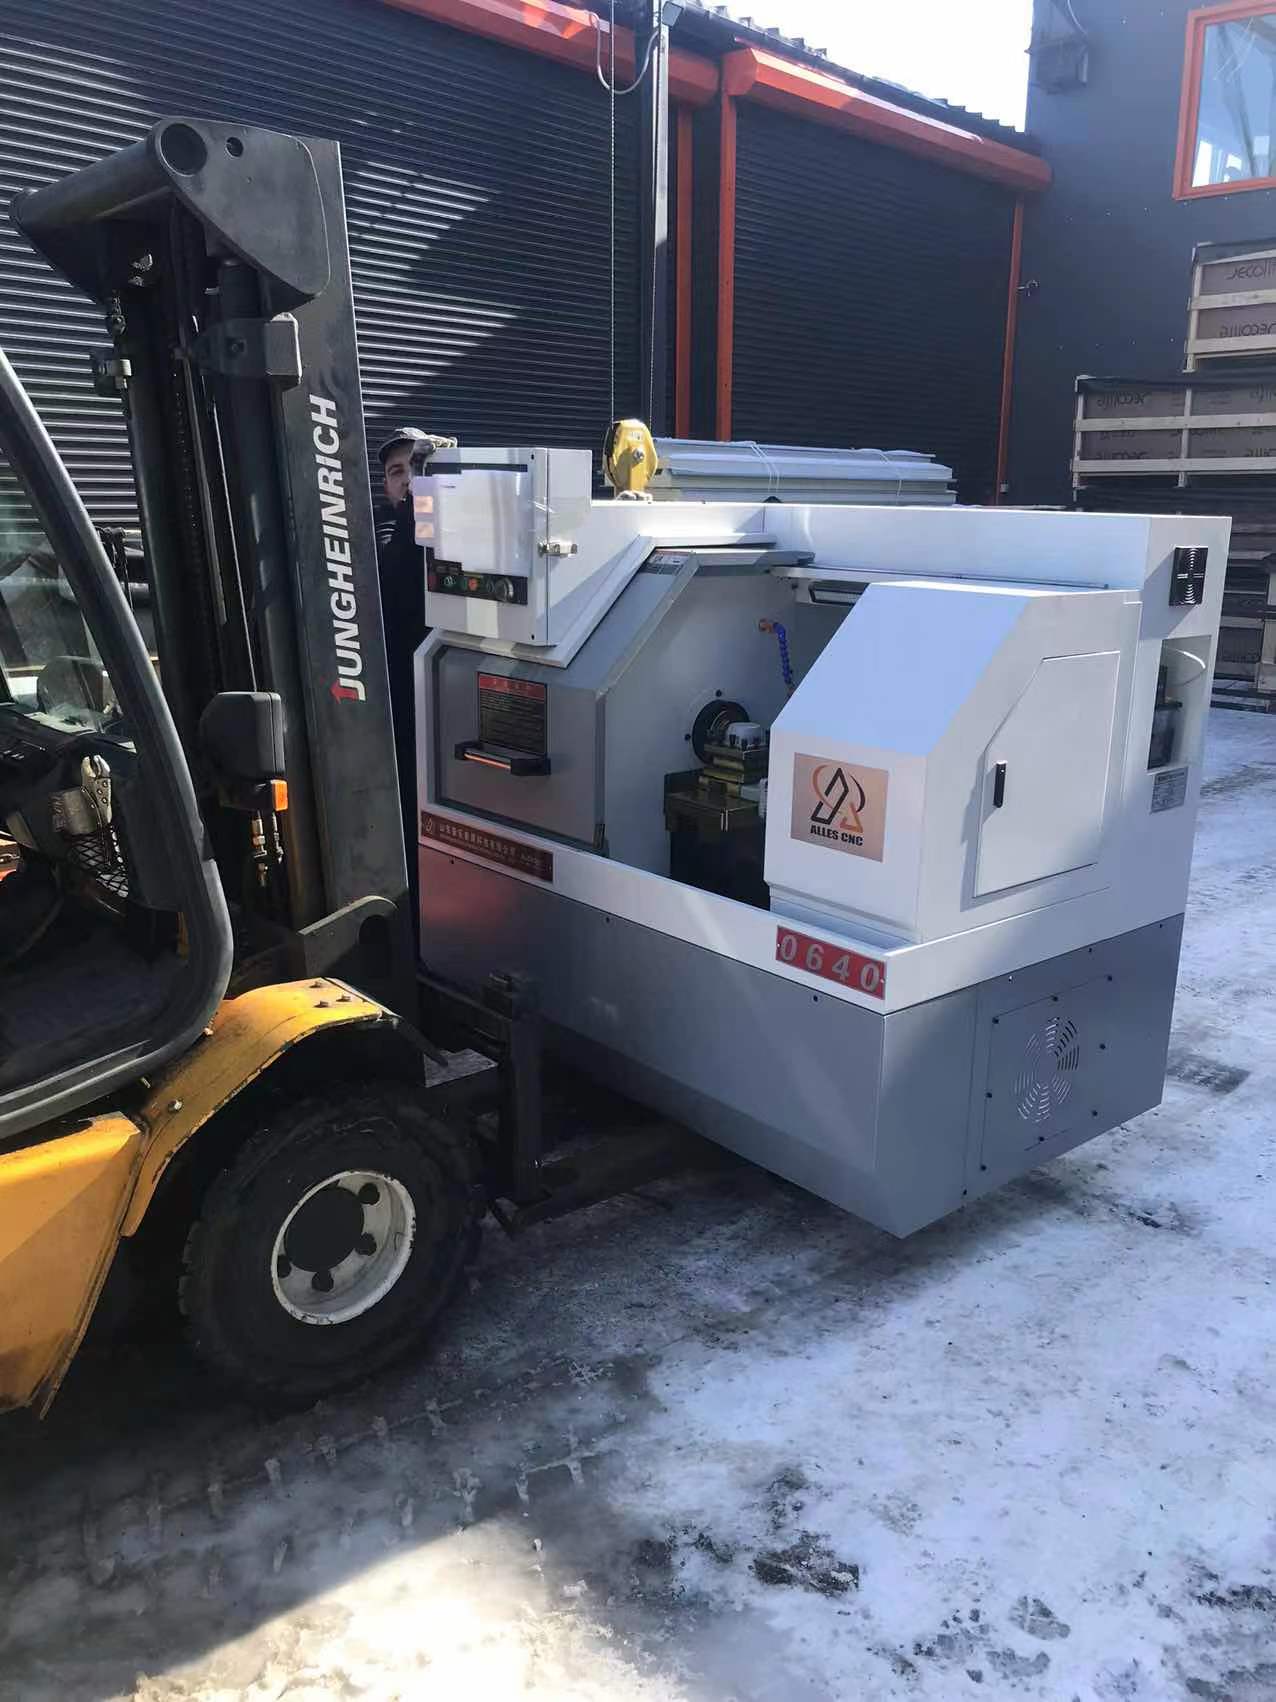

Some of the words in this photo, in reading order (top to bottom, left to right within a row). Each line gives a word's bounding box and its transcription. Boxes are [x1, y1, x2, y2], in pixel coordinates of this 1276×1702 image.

[308, 394, 366, 704] JUNGHEINRICH
[810, 825, 838, 840] ALLES
[841, 833, 863, 846] CNC
[780, 934, 880, 991] 0640
